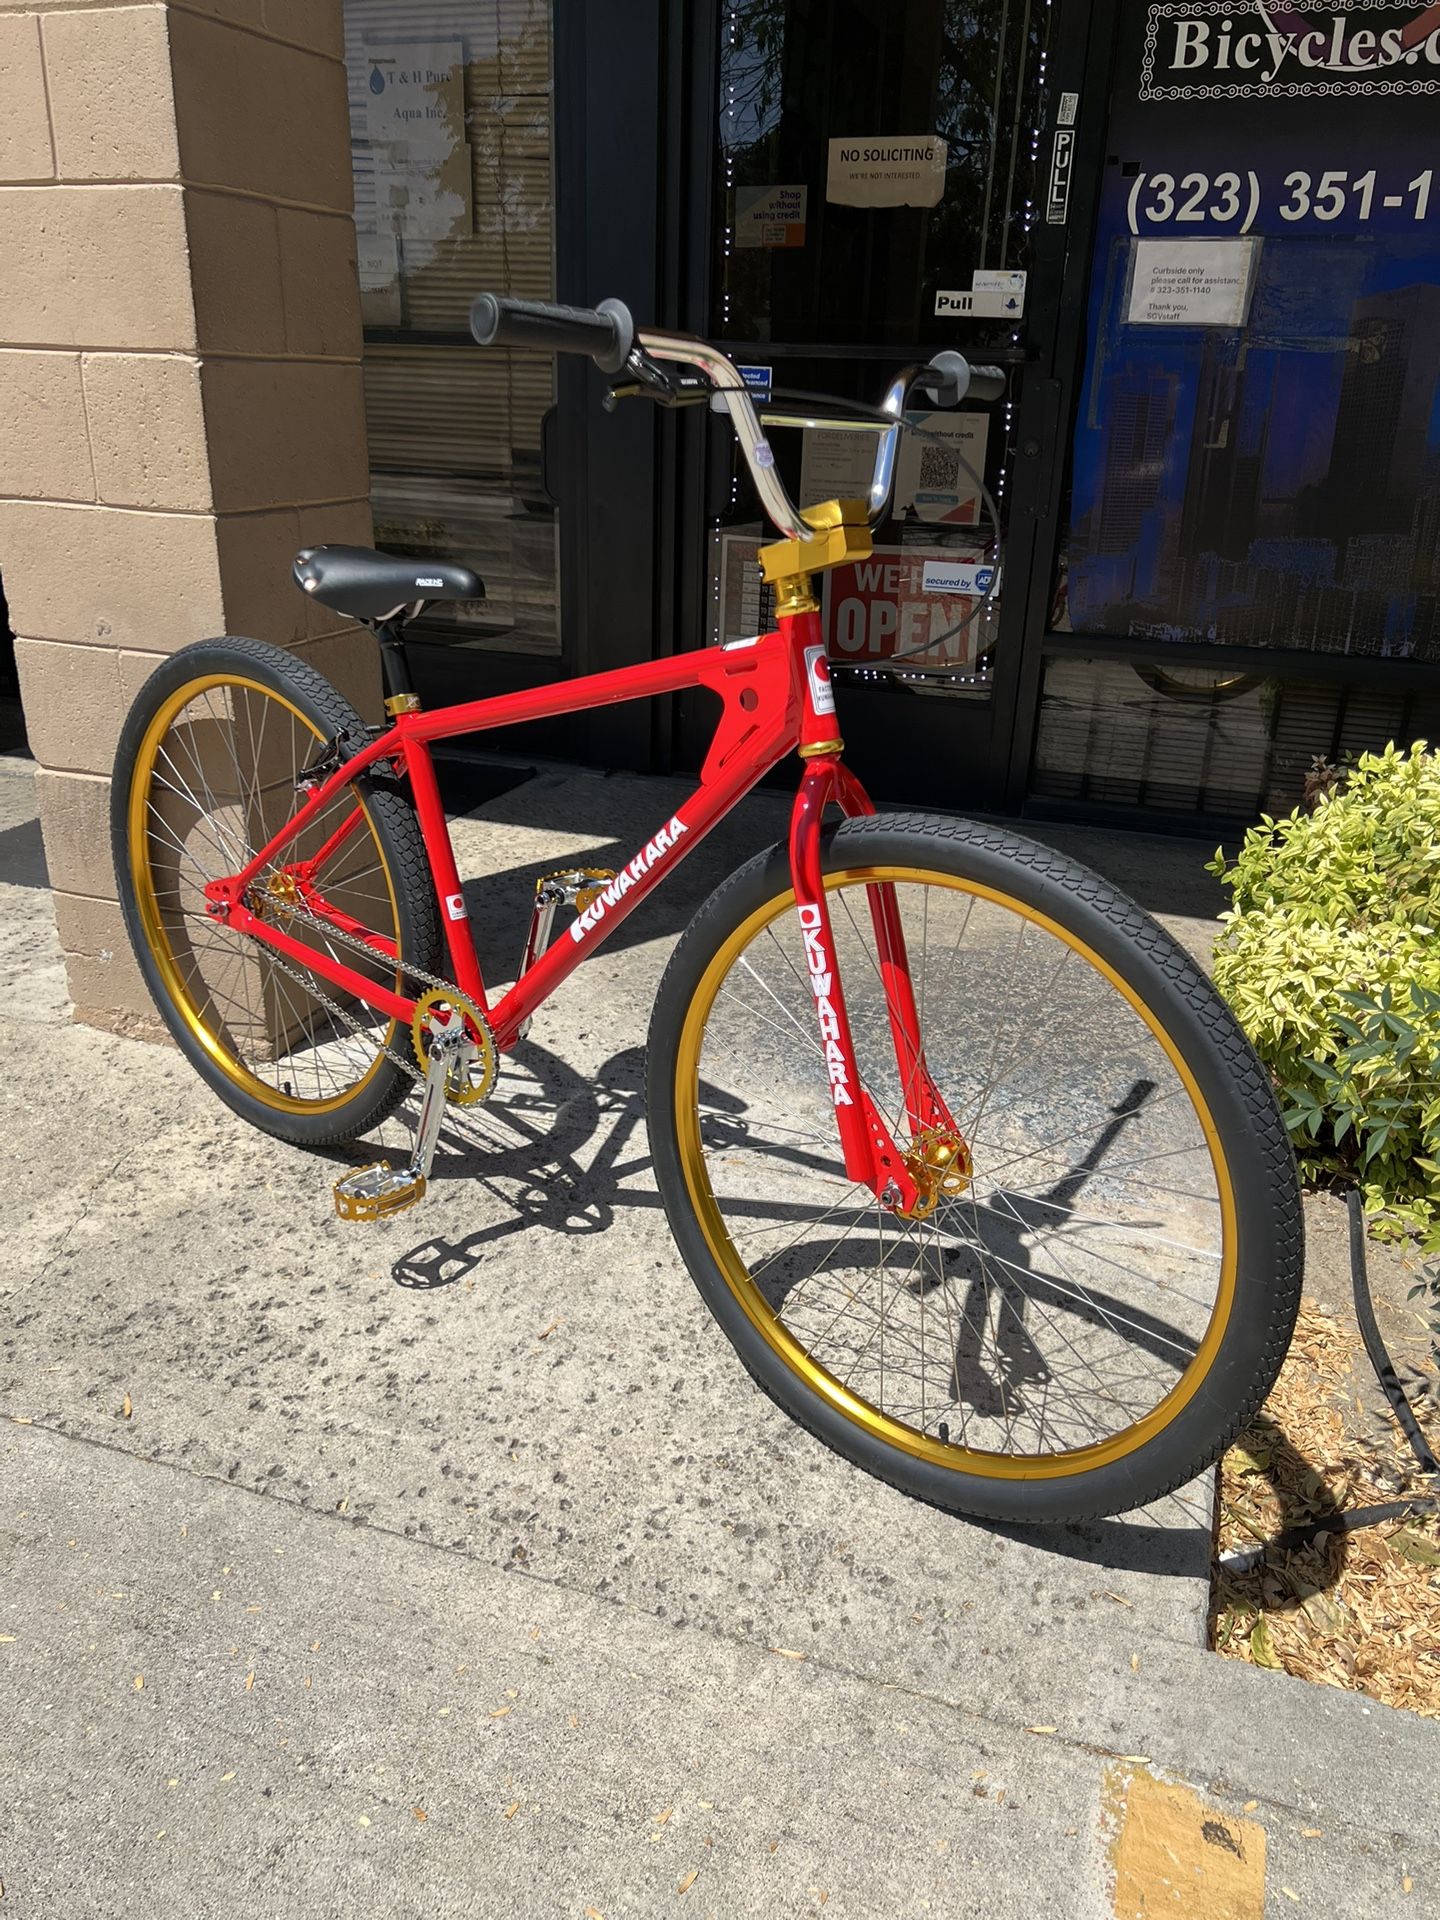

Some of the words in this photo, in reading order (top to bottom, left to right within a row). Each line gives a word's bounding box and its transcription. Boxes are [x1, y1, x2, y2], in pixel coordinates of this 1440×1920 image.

[386, 71, 396, 84] T
[399, 72, 409, 84] &
[412, 71, 422, 83] H
[426, 70, 452, 82] Pure
[393, 107, 422, 121] Aqua
[840, 149, 860, 162] NO
[863, 148, 934, 161] SOLICITING
[1051, 133, 1071, 203] PULL
[870, 172, 883, 180] NOT
[780, 190, 801, 201] Shop
[769, 200, 801, 210] without
[1127, 171, 1260, 235] (323)
[1278, 170, 1440, 222] 351-1
[753, 210, 775, 221] using
[777, 210, 801, 220] credit
[1152, 267, 1187, 275] Curbside
[1188, 267, 1205, 276] only
[1151, 277, 1177, 286] please
[1177, 276, 1191, 285] call
[1192, 276, 1203, 285] for
[1204, 276, 1243, 285] assistanc
[1156, 286, 1211, 294] 323-351-1140
[937, 296, 973, 310] Pull
[1148, 303, 1170, 311] Thank
[1172, 304, 1189, 313] you,
[954, 431, 975, 440] credit
[854, 563, 925, 595] WE'R
[925, 577, 960, 588] secured
[960, 579, 972, 590] by
[836, 597, 963, 658] OPEN
[570, 815, 690, 944] KUWAHARA
[801, 927, 854, 1106] KUWAHARA
